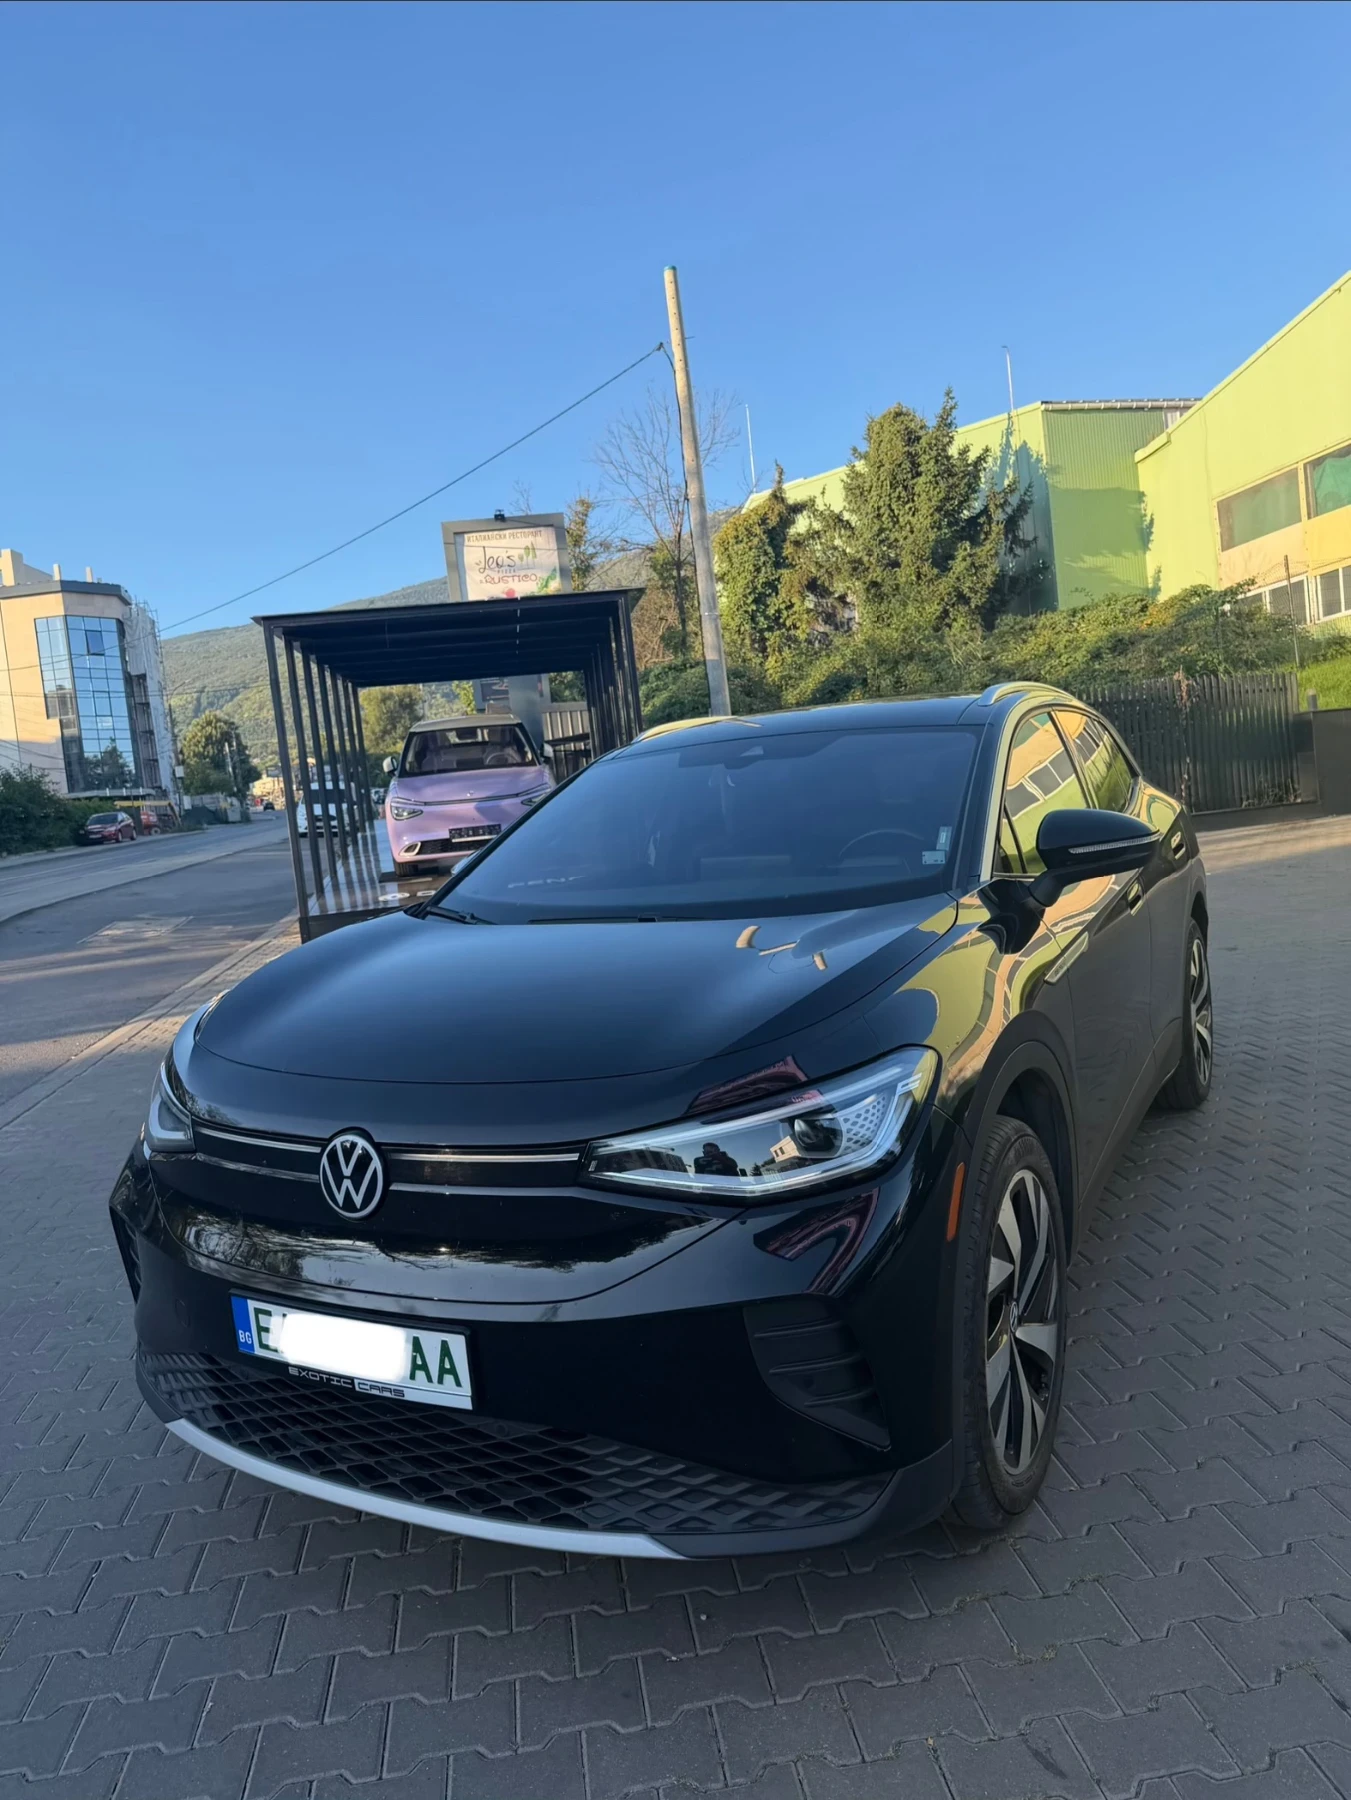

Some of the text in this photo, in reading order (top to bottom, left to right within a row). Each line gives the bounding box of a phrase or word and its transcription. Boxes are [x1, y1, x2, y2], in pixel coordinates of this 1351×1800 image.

[508, 530, 542, 540] РЕСТОРАНТ
[239, 1329, 252, 1344] BG
[254, 1307, 462, 1388] E AA
[288, 1366, 405, 1398] EXOTIC CARS
